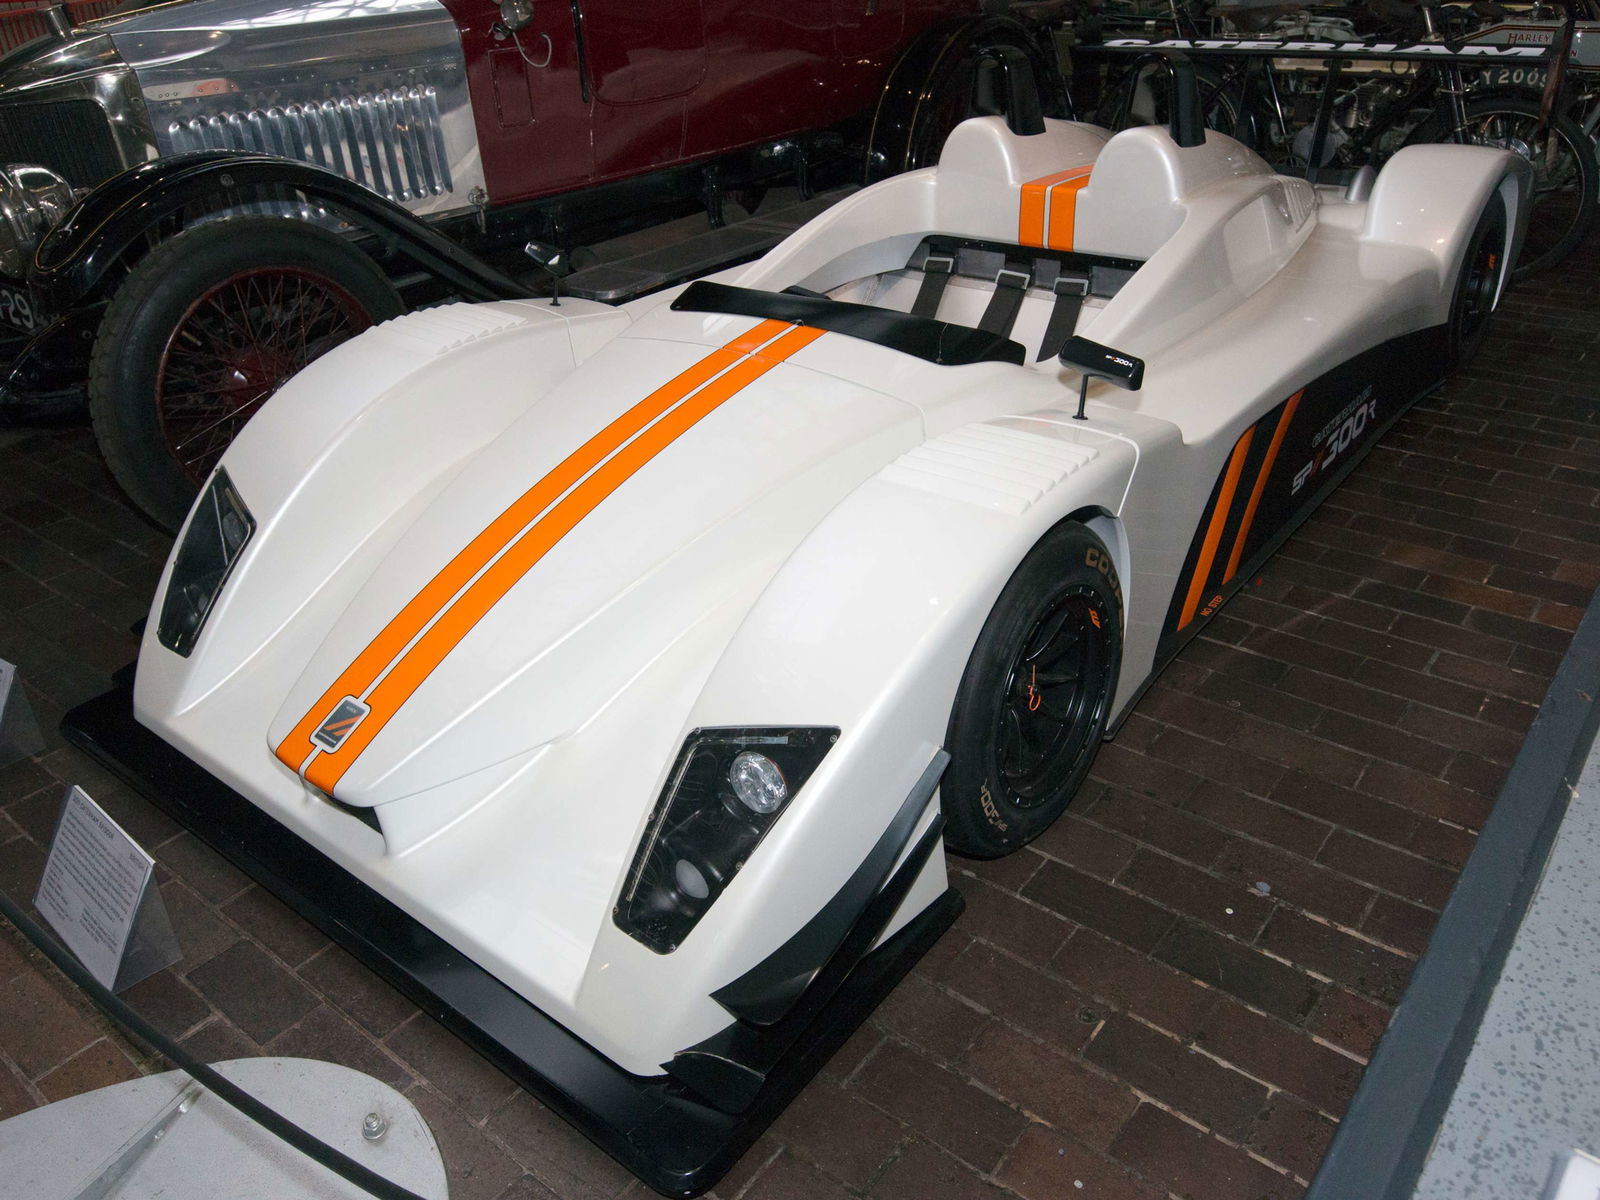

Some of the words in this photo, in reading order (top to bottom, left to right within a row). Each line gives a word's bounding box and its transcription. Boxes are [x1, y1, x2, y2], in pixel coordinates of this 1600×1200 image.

[1508, 33, 1552, 45] HARLEY
[1104, 39, 1546, 56] CATERHAM
[0, 289, 34, 329] 29
[1208, 594, 1224, 609] STEP
